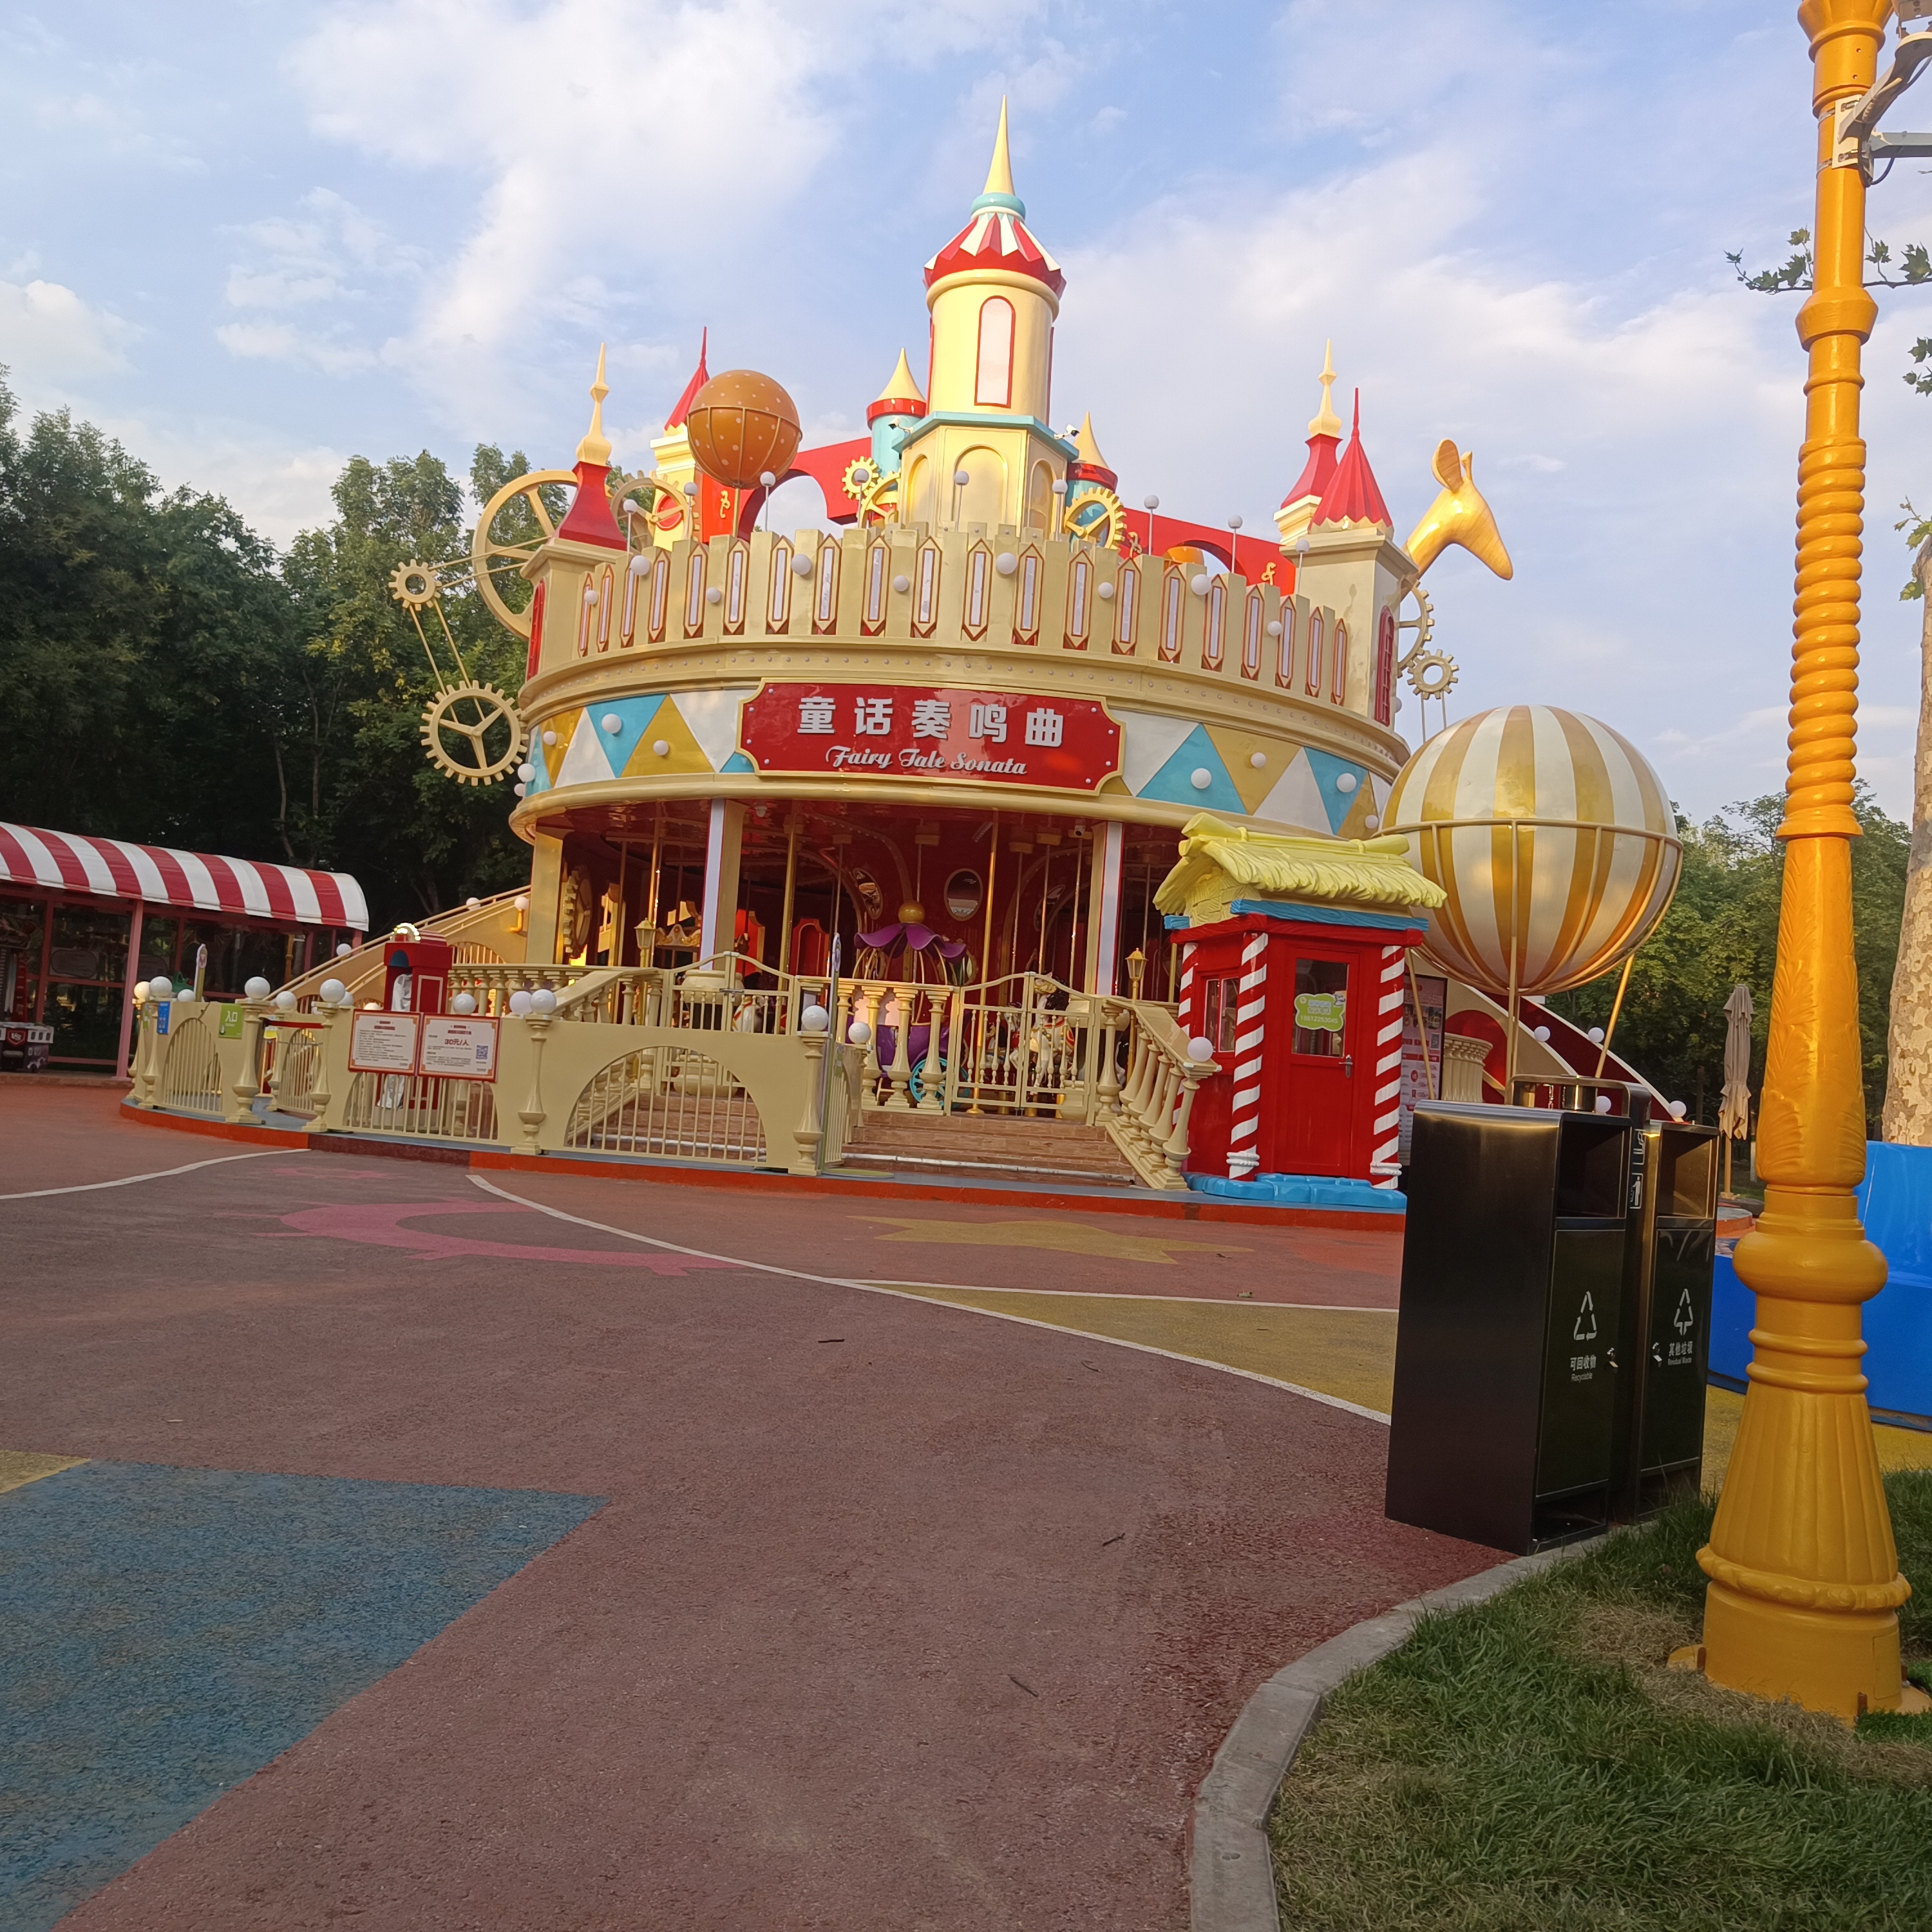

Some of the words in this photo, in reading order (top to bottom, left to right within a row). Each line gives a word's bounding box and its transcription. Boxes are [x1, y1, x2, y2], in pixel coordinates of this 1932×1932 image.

[797, 697, 1064, 748] 童话奏鸣曲
[826, 745, 893, 769] Fairy
[898, 749, 946, 769] Tale
[951, 751, 1027, 775] Sonata
[225, 1010, 238, 1022] 入口
[1570, 1354, 1596, 1371] 可回收物
